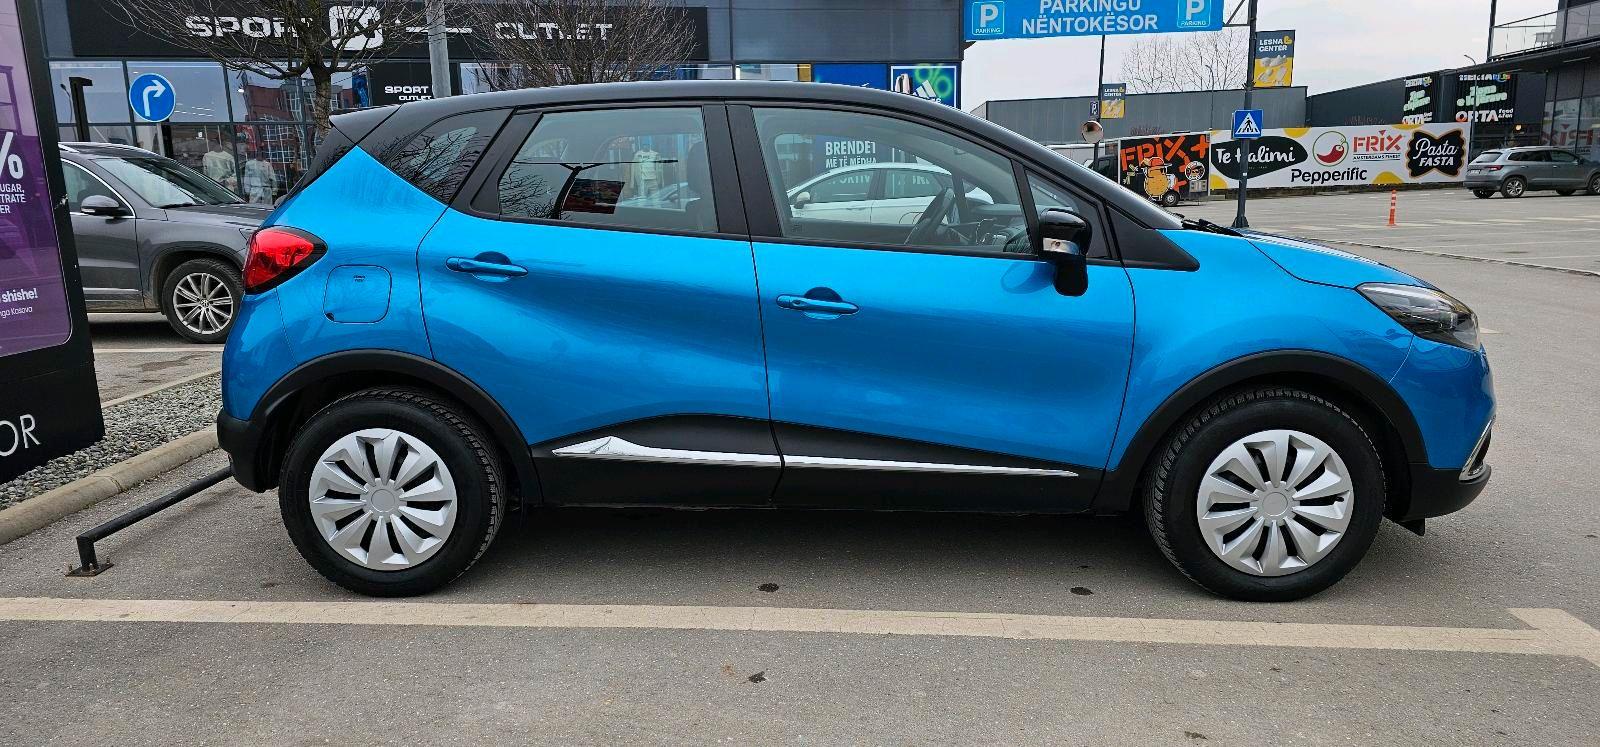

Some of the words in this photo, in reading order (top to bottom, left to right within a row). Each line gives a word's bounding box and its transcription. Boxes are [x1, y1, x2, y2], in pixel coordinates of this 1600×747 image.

[1040, 0, 1141, 14] PARKINGU
[1022, 13, 1158, 35] NËNTOKËSOR
[384, 85, 429, 94] SPORT
[1455, 109, 1499, 123] ORTA
[1215, 148, 1232, 164] Te
[1413, 137, 1458, 160] Pasta
[1419, 156, 1454, 167] FASTA
[1290, 167, 1368, 184] Pepperific
[1, 287, 39, 303] shishe!
